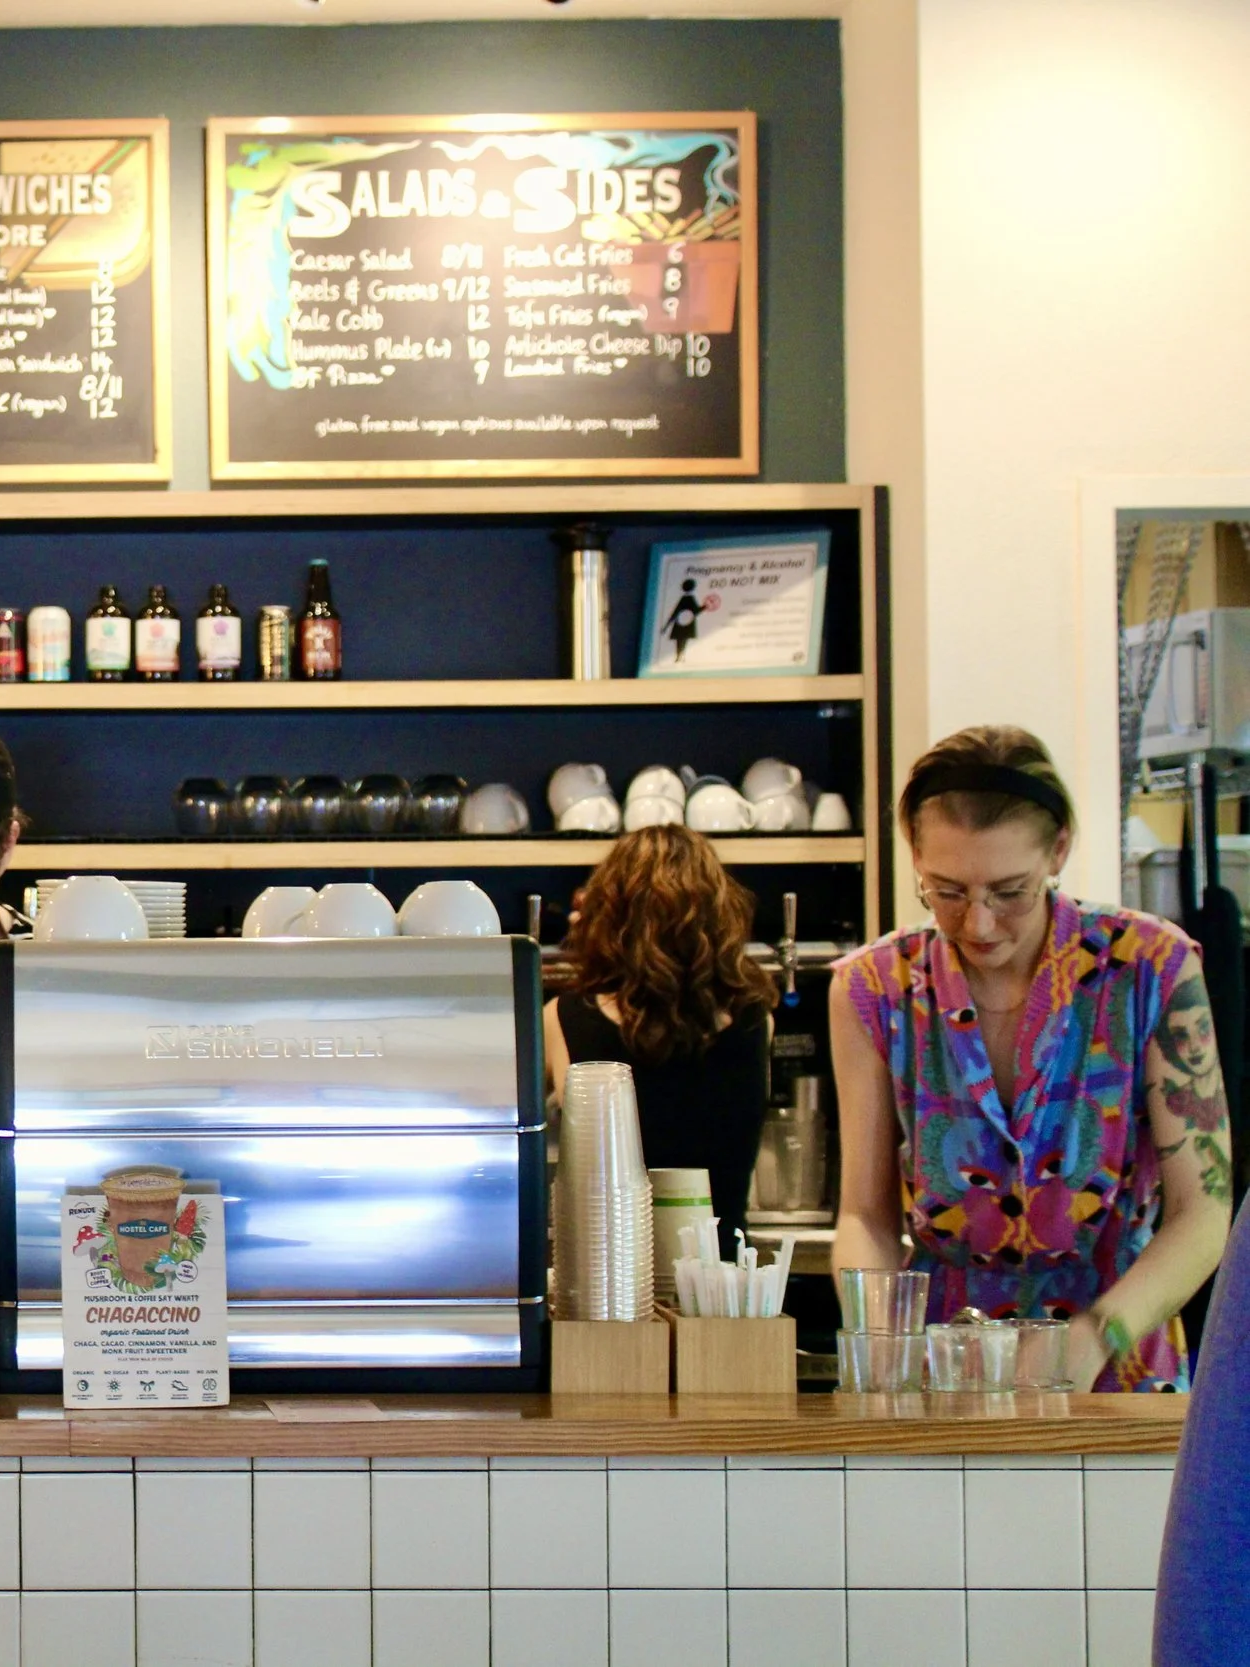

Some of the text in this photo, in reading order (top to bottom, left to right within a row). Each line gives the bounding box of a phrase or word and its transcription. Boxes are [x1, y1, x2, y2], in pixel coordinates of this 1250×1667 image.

[287, 166, 682, 238] SALADS SIDES
[359, 246, 413, 272] Salad
[667, 242, 684, 264] 6
[90, 327, 117, 349] 12
[590, 331, 650, 355] Cheese
[655, 333, 682, 361] Dip
[686, 331, 710, 357] 10
[90, 398, 118, 420] 12
[710, 574, 781, 589] DO NOT MIX
[187, 1036, 385, 1059] SIMONELLI
[69, 1207, 96, 1216] RENUDE
[86, 1306, 200, 1324] CHAGACCINO
[131, 1328, 166, 1336] Featured
